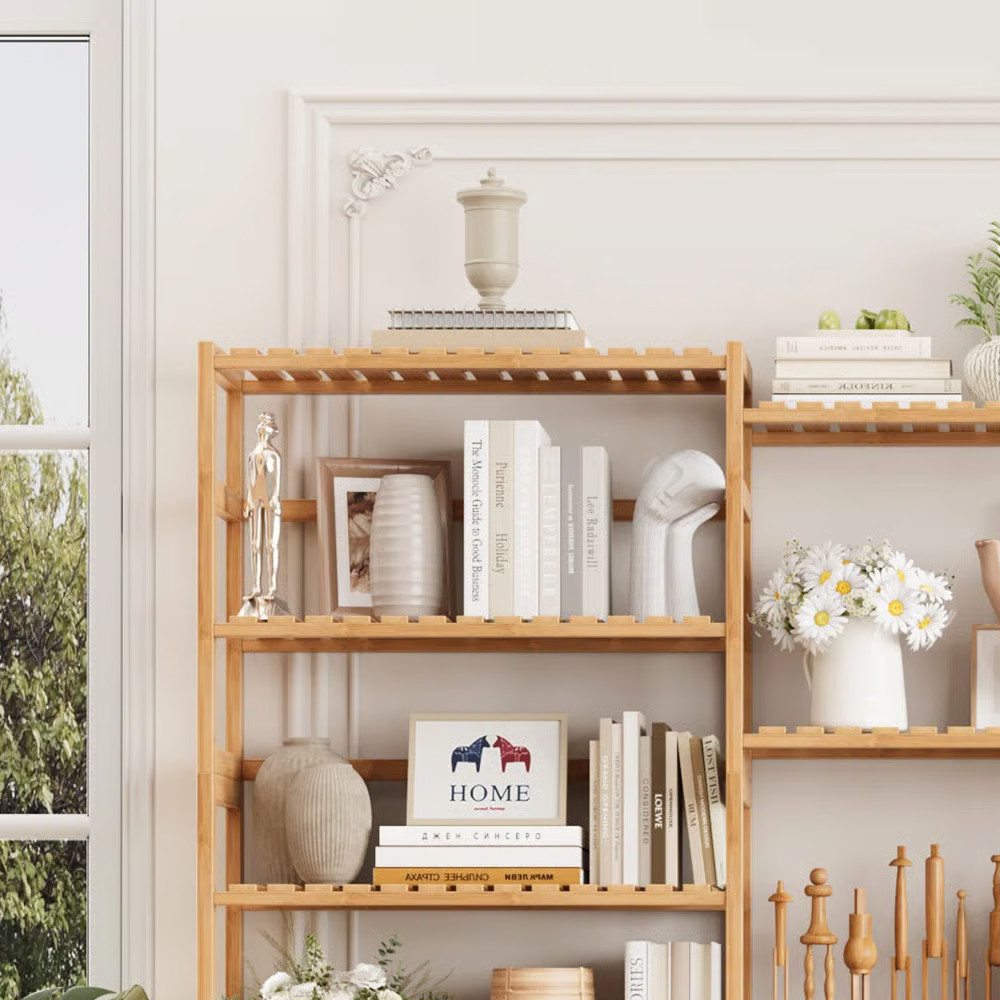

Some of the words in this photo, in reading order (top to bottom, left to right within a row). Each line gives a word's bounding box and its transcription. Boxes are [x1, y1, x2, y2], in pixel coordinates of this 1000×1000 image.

[472, 439, 482, 457] The
[472, 460, 482, 497] Monocle
[472, 499, 482, 526] Guide
[472, 528, 482, 538] to
[587, 518, 598, 568] Radziwill
[472, 538, 482, 563] Good
[492, 533, 508, 575] Holiday
[472, 565, 482, 602] Business
[705, 740, 716, 772] LOST
[450, 784, 530, 802] HOME
[708, 774, 719, 805] FISH
[654, 793, 663, 829] LOEWE
[422, 832, 461, 841] ДЖЕН
[473, 832, 542, 840] СИНСЕРО
